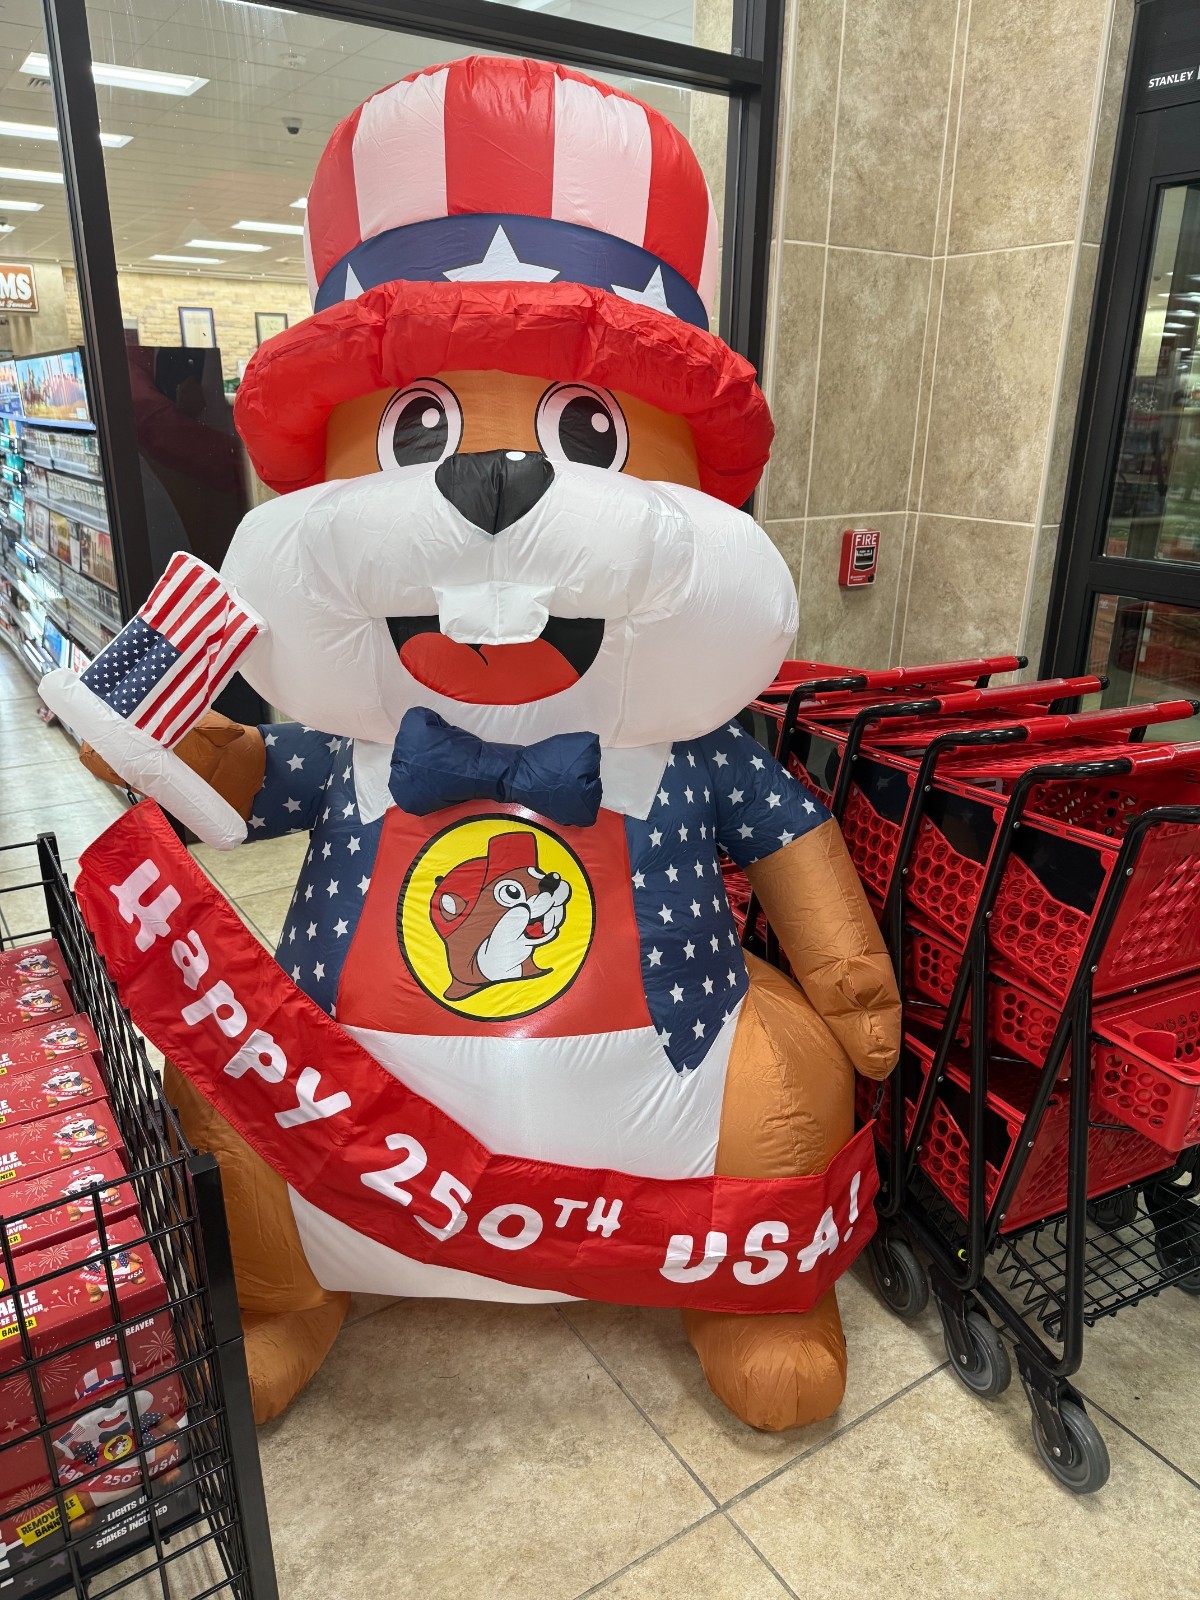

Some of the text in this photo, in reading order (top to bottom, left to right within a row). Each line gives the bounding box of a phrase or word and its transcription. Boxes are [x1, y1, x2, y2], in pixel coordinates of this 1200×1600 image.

[1148, 70, 1194, 88] STANLEY
[855, 533, 877, 546] FIRE
[109, 858, 351, 1129] Happy
[659, 1170, 861, 1286] USA!
[12, 1303, 44, 1322] BAVER
[2, 1319, 34, 1338] BANER
[125, 1318, 155, 1337] BEAVER
[149, 1449, 180, 1477] USA!
[21, 1499, 76, 1535] REMOVALE
[107, 1500, 137, 1522] LIGHTS
[96, 1527, 127, 1549] STAKES
